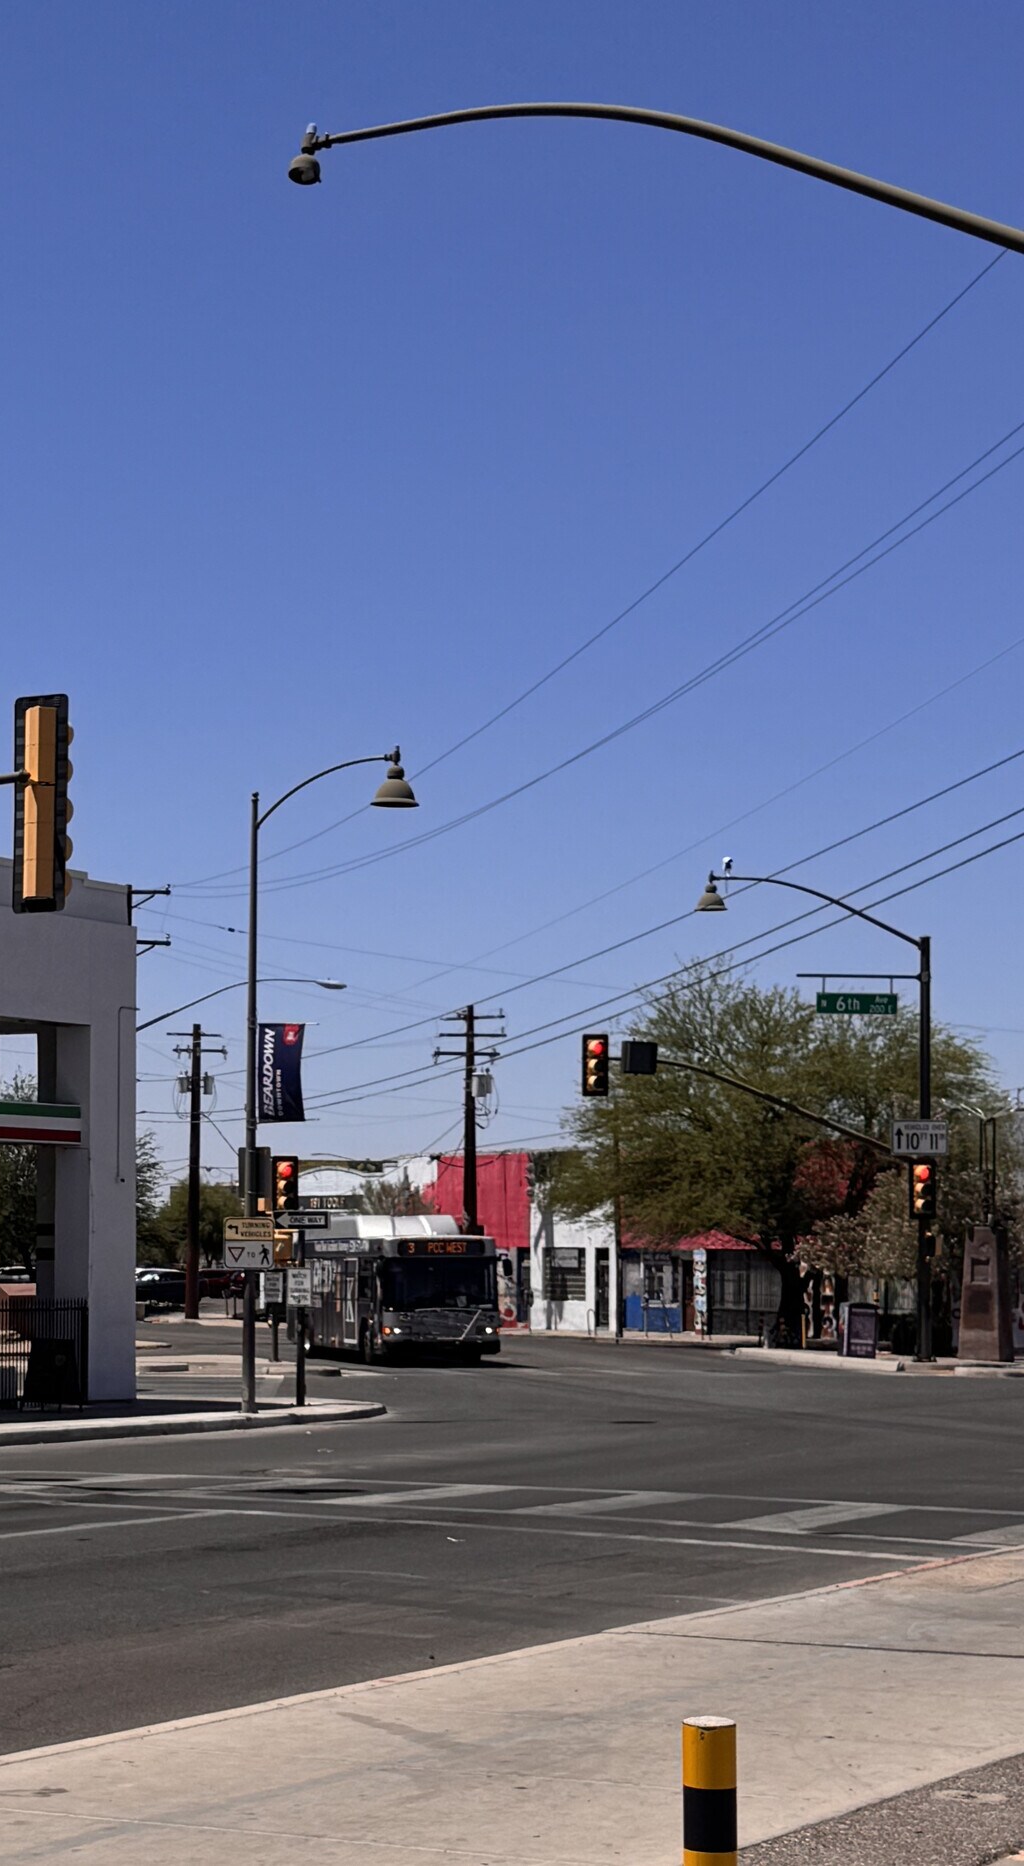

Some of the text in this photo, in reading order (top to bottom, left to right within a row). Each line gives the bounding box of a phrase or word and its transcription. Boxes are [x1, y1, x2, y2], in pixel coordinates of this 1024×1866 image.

[836, 996, 861, 1012] 6th
[906, 1132, 920, 1151] 10
[289, 1216, 324, 1224] ONE WAY
[408, 1242, 416, 1254] 3
[446, 1241, 467, 1253] WEST
